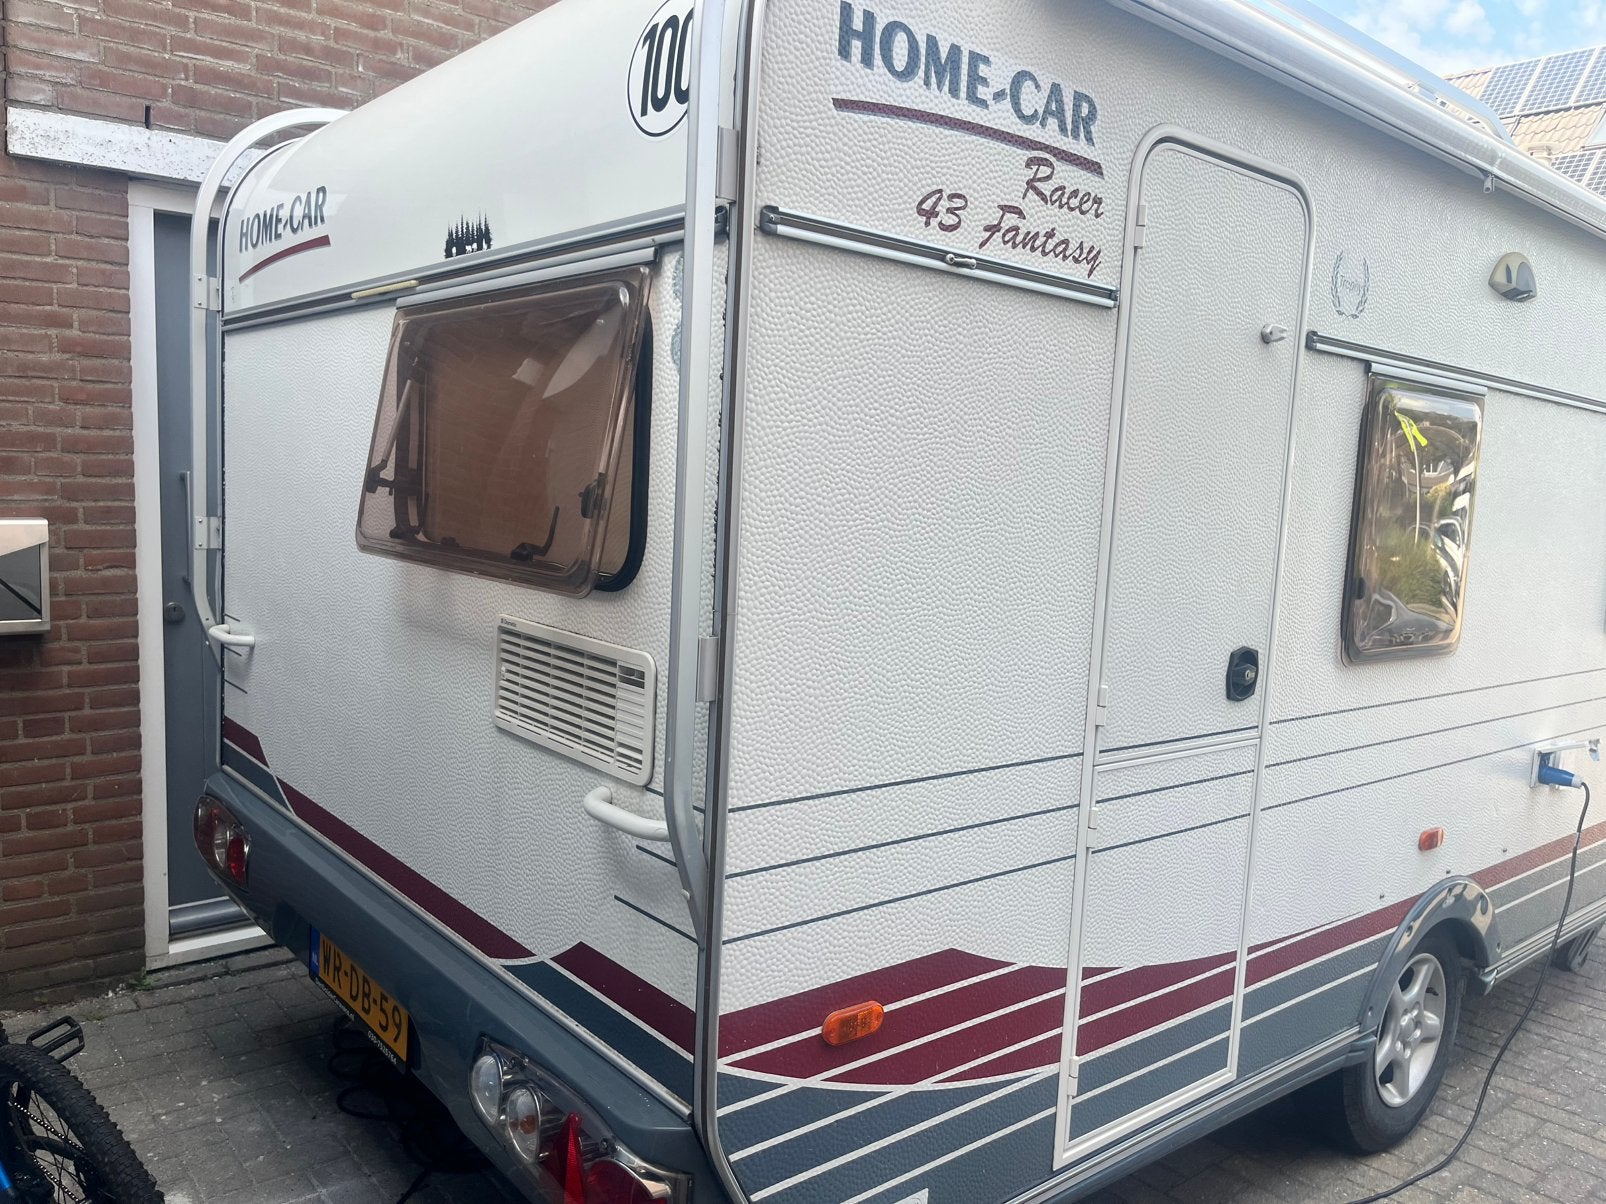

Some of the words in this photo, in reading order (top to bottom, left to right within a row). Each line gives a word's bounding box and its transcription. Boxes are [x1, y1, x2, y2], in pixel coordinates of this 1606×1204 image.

[838, 0, 1098, 147] HOME-CAR
[239, 185, 327, 254] HOME-CAR
[1022, 156, 1104, 219] Racer
[916, 188, 969, 233] 43
[979, 204, 1102, 279] Fantasy
[322, 938, 403, 1044] WR-DB-59
